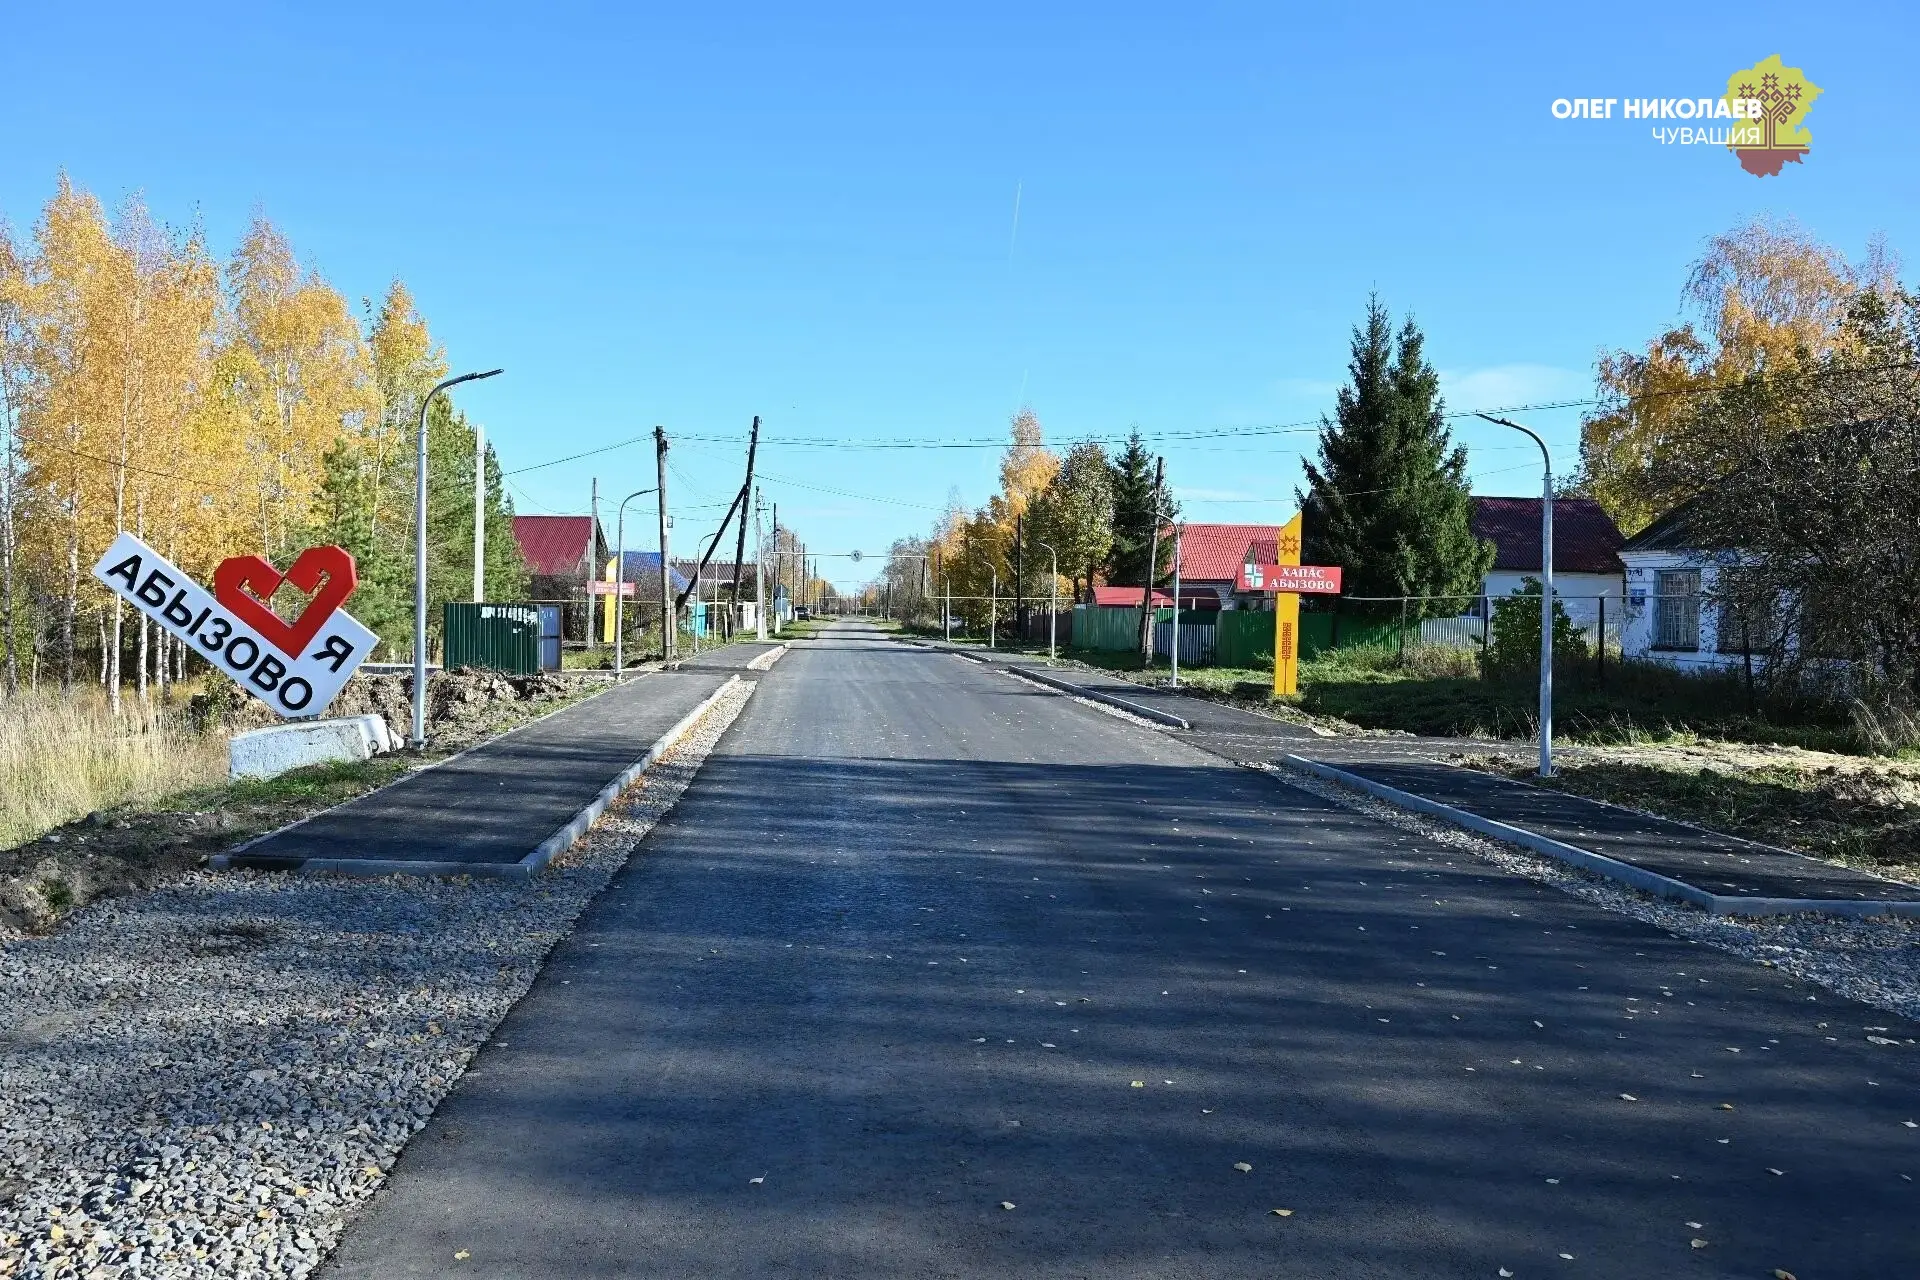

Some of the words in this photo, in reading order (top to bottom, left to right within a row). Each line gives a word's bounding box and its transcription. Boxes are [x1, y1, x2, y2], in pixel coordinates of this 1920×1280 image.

[1270, 579, 1335, 590] АБЫЗОВО
[105, 554, 313, 711] АБЫЗОВО
[312, 635, 355, 673] Я
